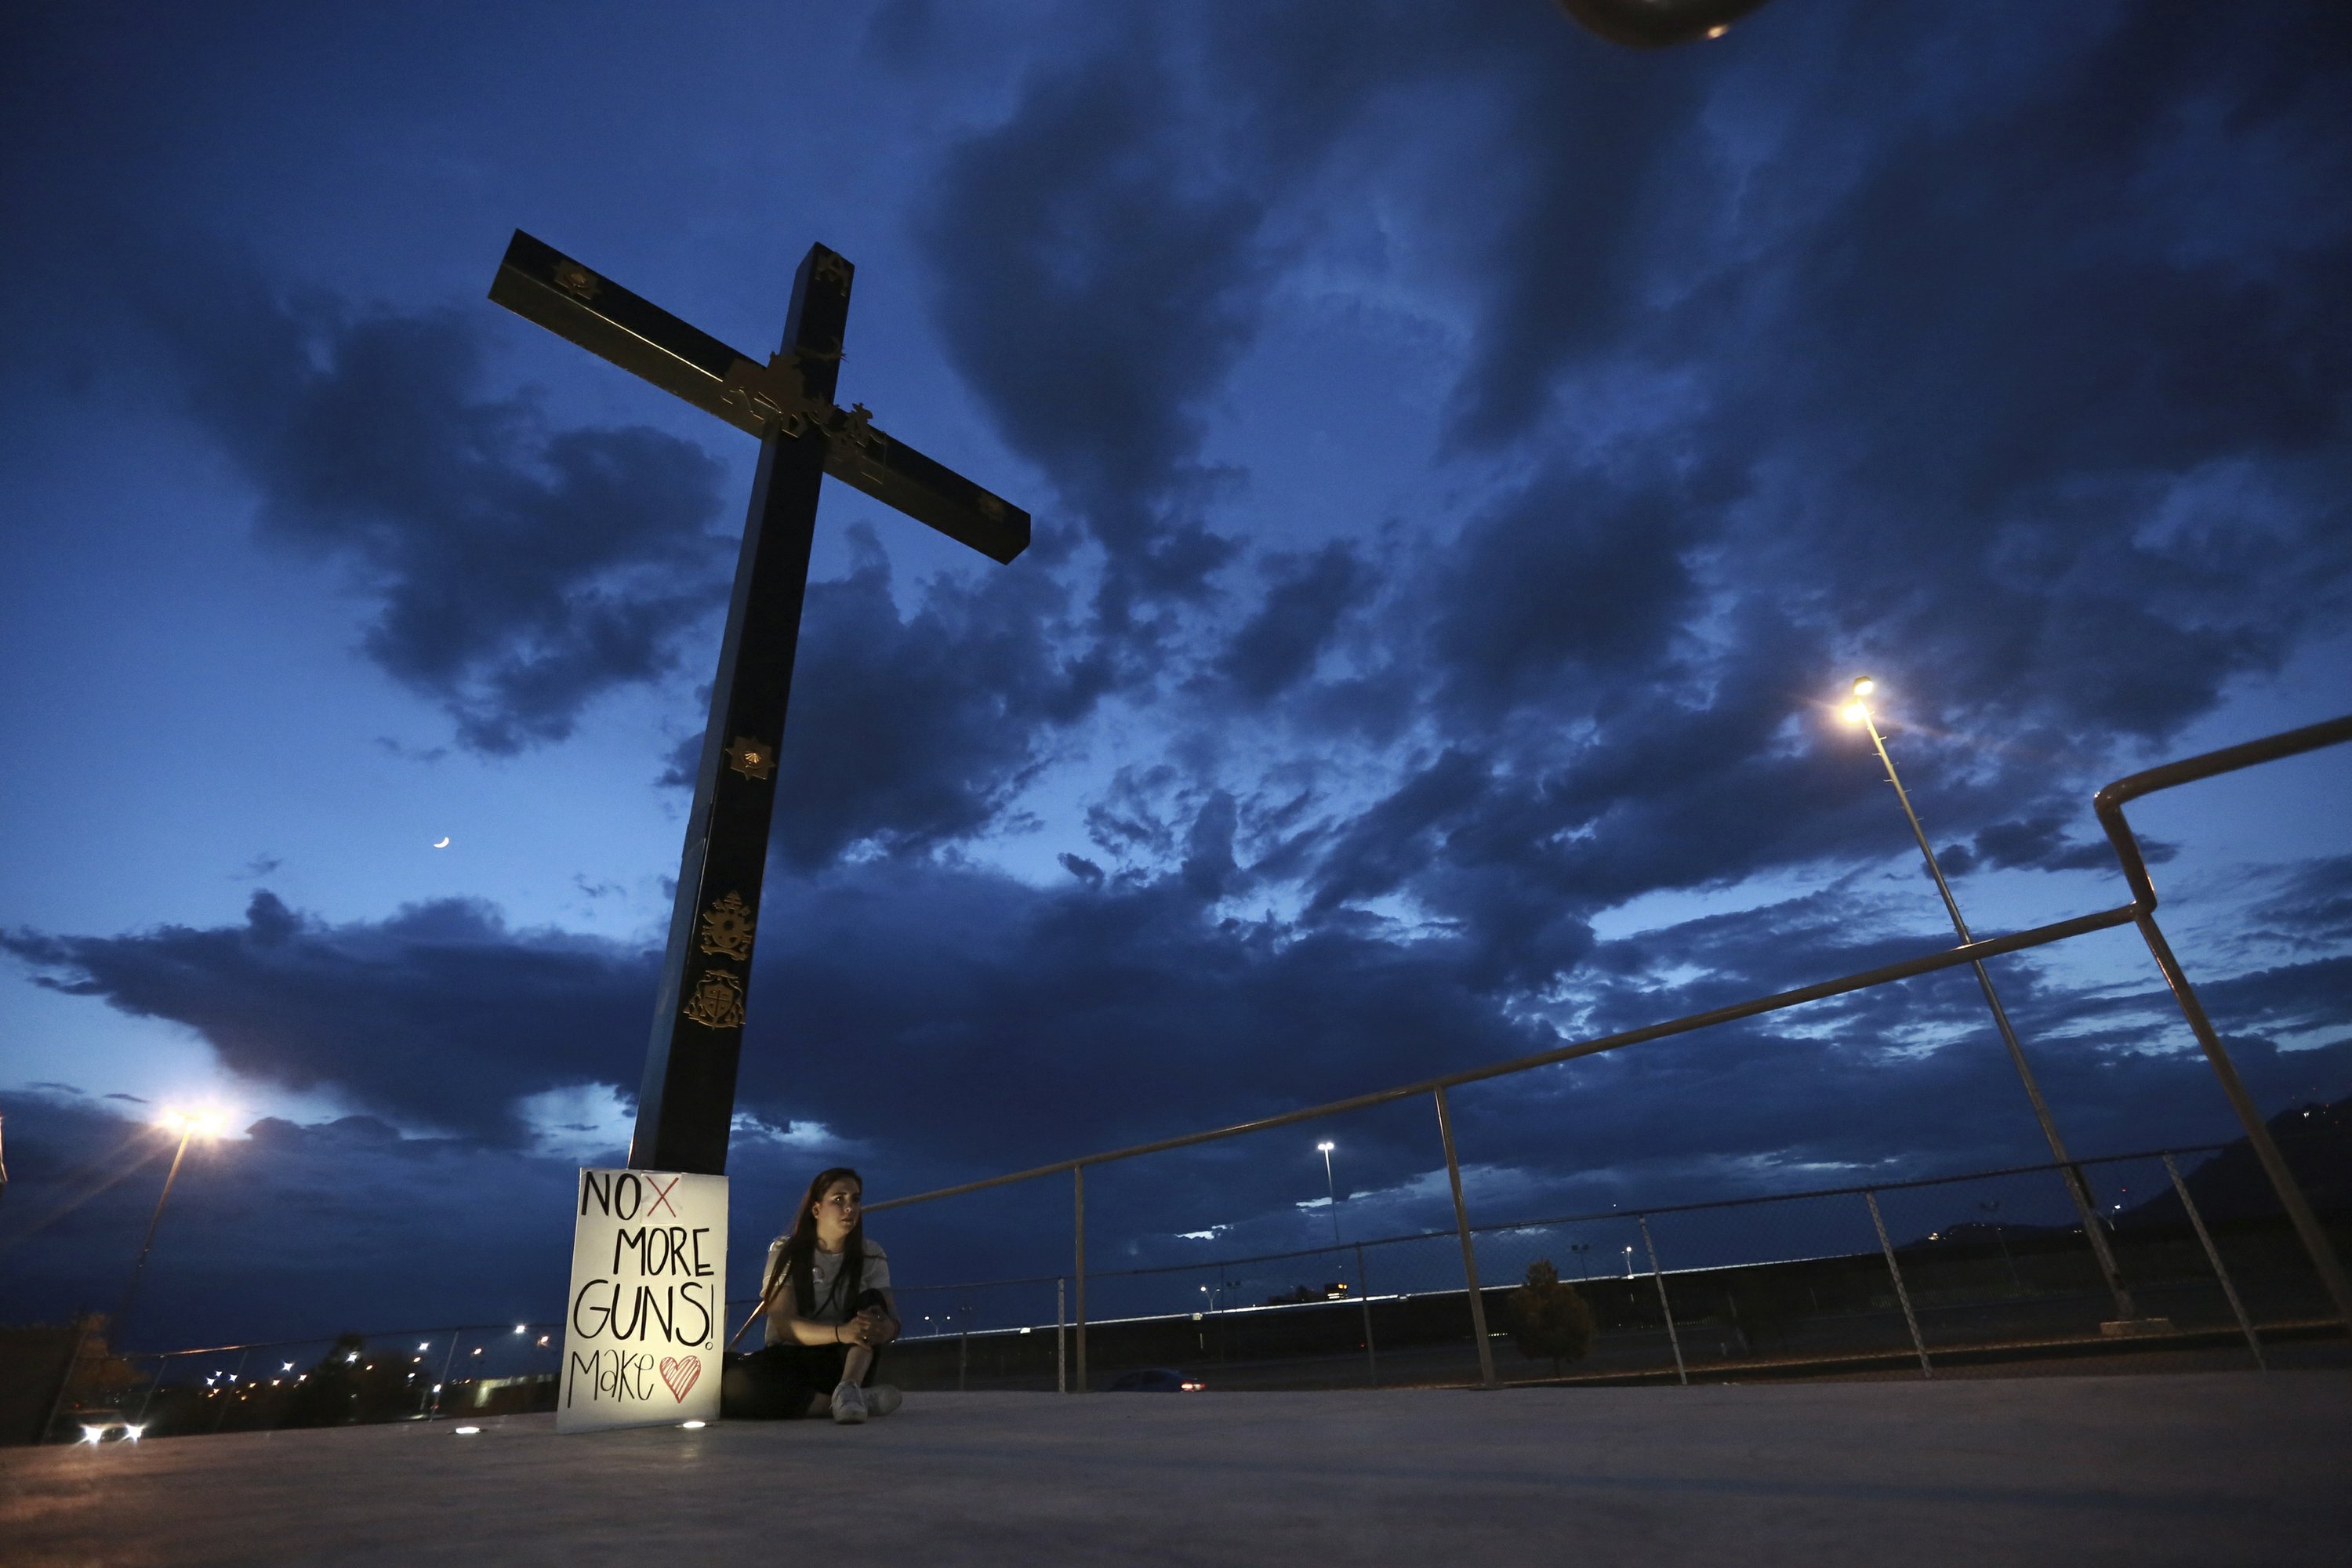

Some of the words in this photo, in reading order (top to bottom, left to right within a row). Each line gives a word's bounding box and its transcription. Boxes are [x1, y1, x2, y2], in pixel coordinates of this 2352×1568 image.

[613, 1226, 714, 1277] MORE
[573, 1279, 714, 1351] GUNS!
[568, 1349, 655, 1408] Make
